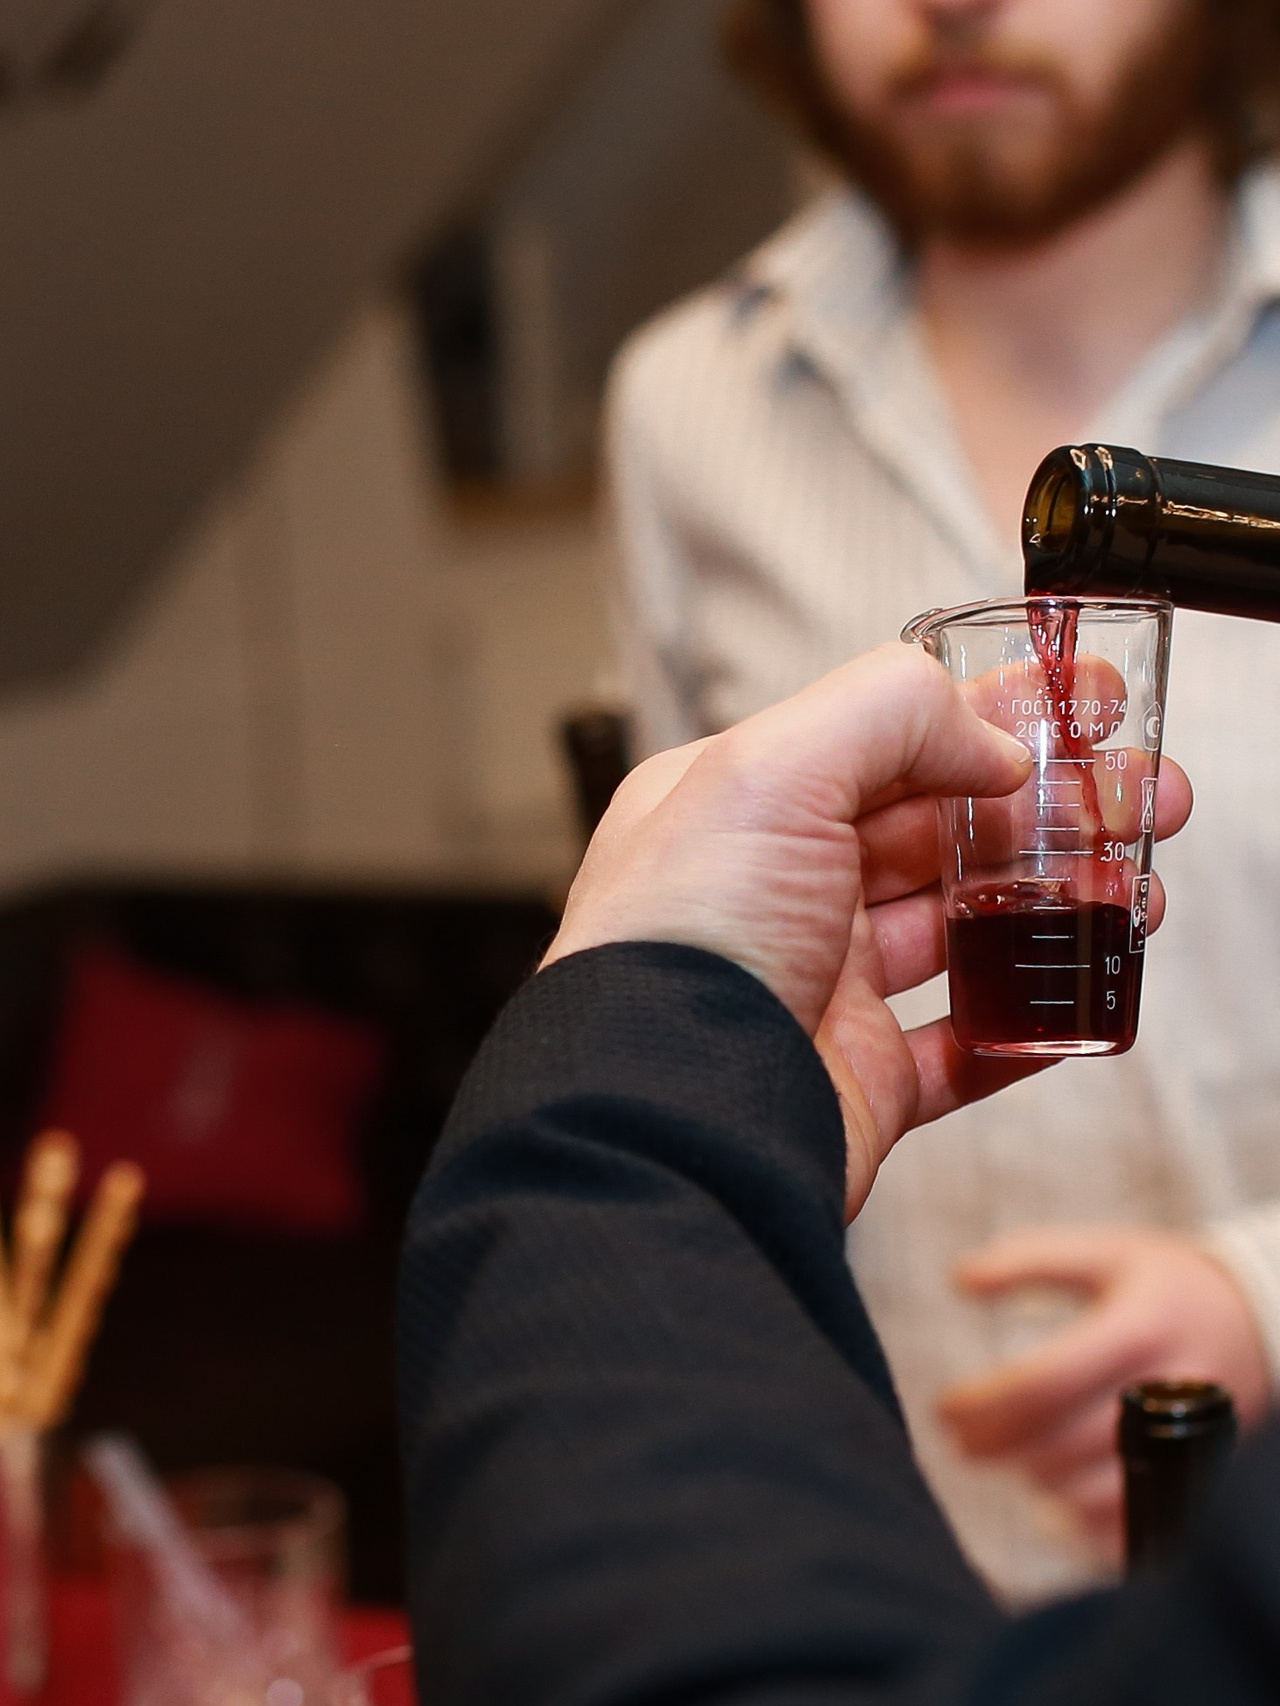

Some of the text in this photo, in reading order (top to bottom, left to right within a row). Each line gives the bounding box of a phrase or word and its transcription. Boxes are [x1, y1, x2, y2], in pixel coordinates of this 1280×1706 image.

[1010, 699, 1127, 715] ГОСТ 1770-74
[1104, 750, 1128, 771] 50
[1102, 842, 1126, 862] 30
[1104, 956, 1121, 975] 10
[1105, 990, 1117, 1010] 5
